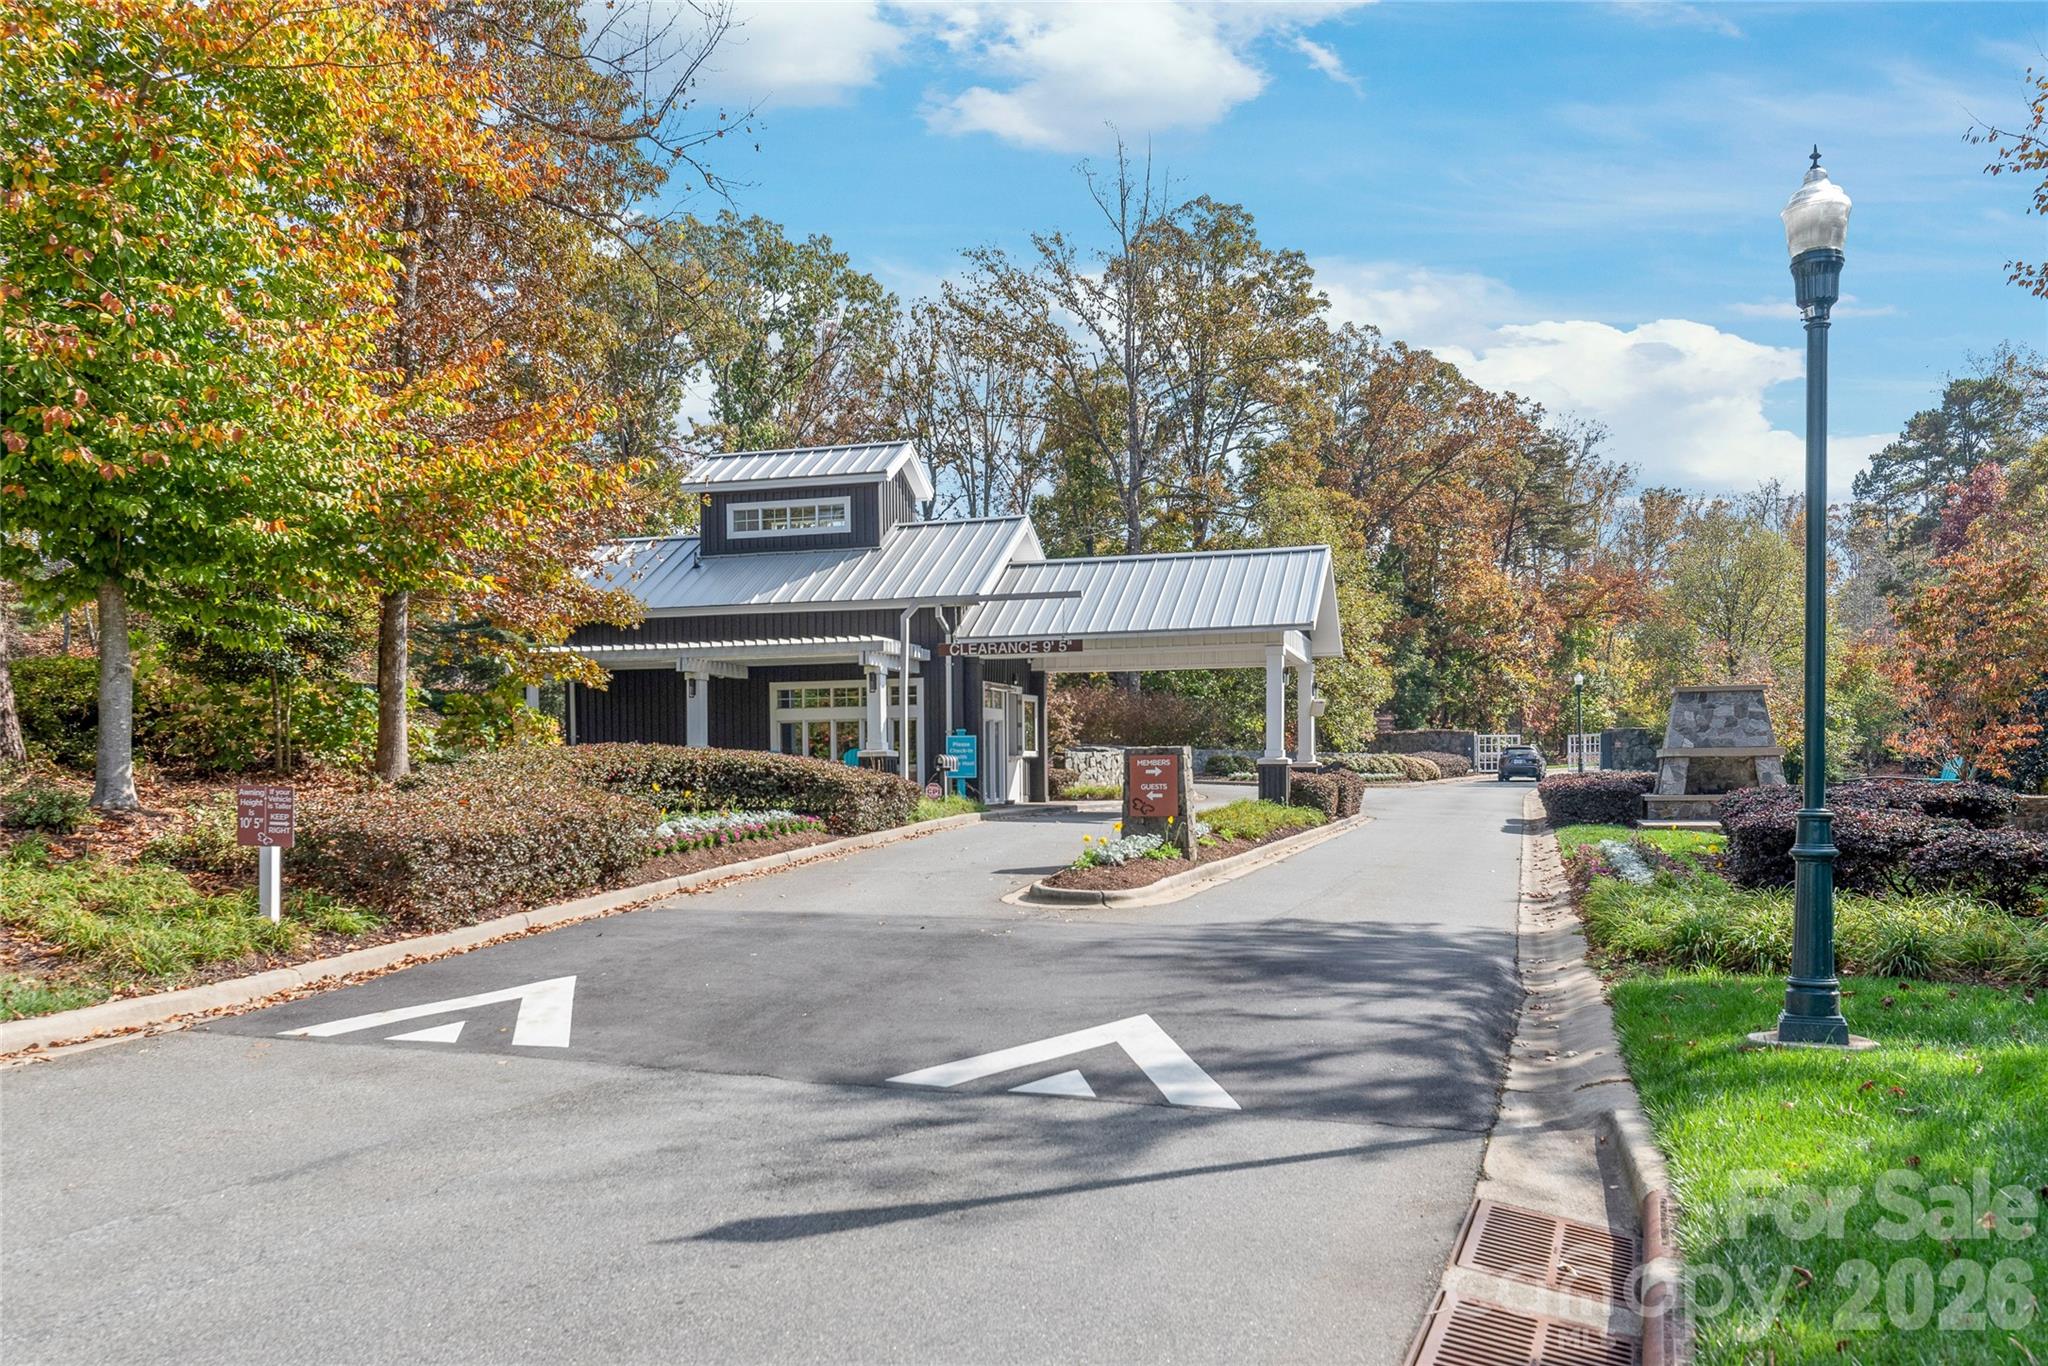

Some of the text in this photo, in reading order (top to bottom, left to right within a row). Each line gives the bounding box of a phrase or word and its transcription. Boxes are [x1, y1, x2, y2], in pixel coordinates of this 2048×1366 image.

[949, 639, 1073, 656] CLEARANCE 9' 5"
[239, 788, 265, 797] Awning
[240, 798, 263, 807] Height
[240, 817, 264, 829] 10' 5"
